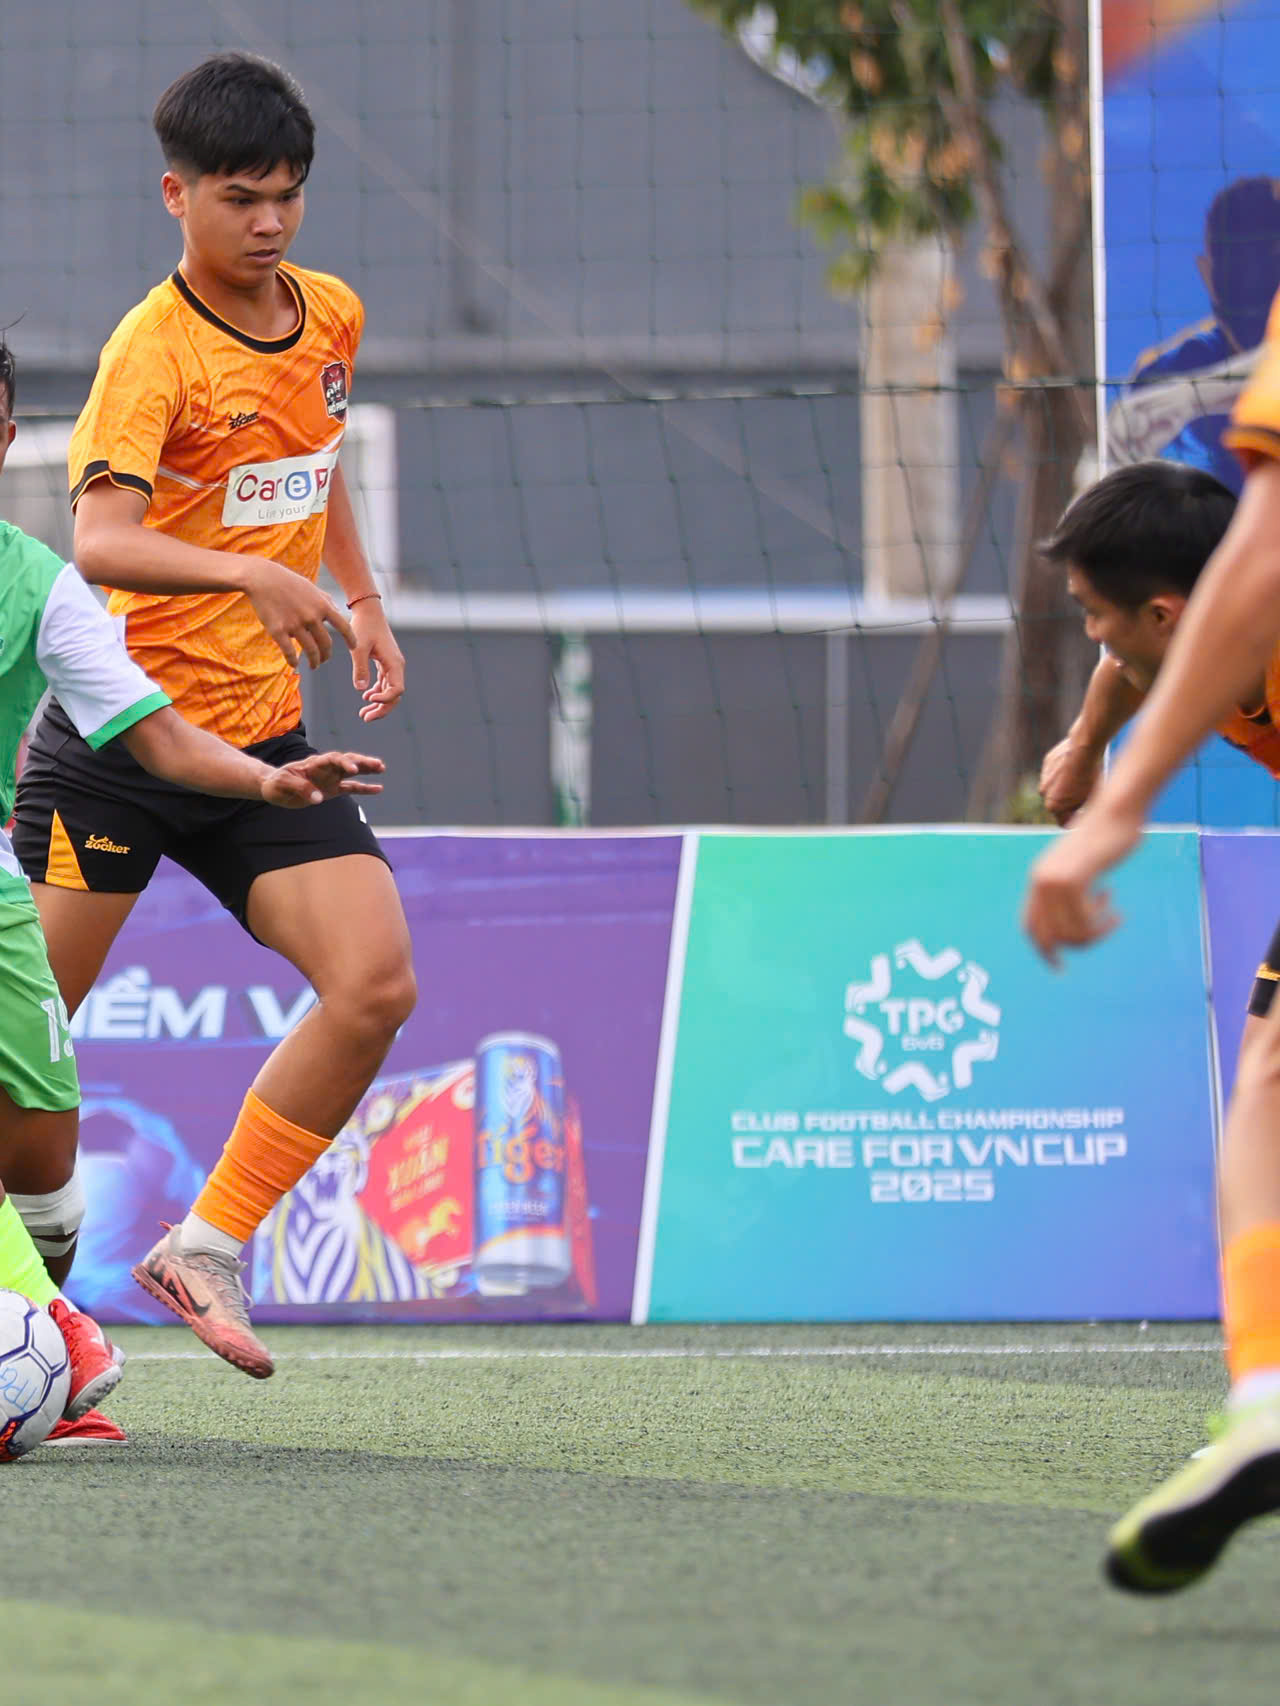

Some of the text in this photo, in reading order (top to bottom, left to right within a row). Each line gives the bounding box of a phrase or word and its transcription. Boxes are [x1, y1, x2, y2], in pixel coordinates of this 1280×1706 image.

[236, 468, 328, 502] CareP
[84, 835, 132, 855] zocker
[70, 964, 228, 1040] IỀM
[879, 998, 965, 1036] TPG
[730, 1106, 1125, 1133] CLUB FOOTBALL CHAMPIONSHIP
[730, 1132, 1128, 1169] CARE FOR VN CUP
[870, 1168, 995, 1202] 2025
